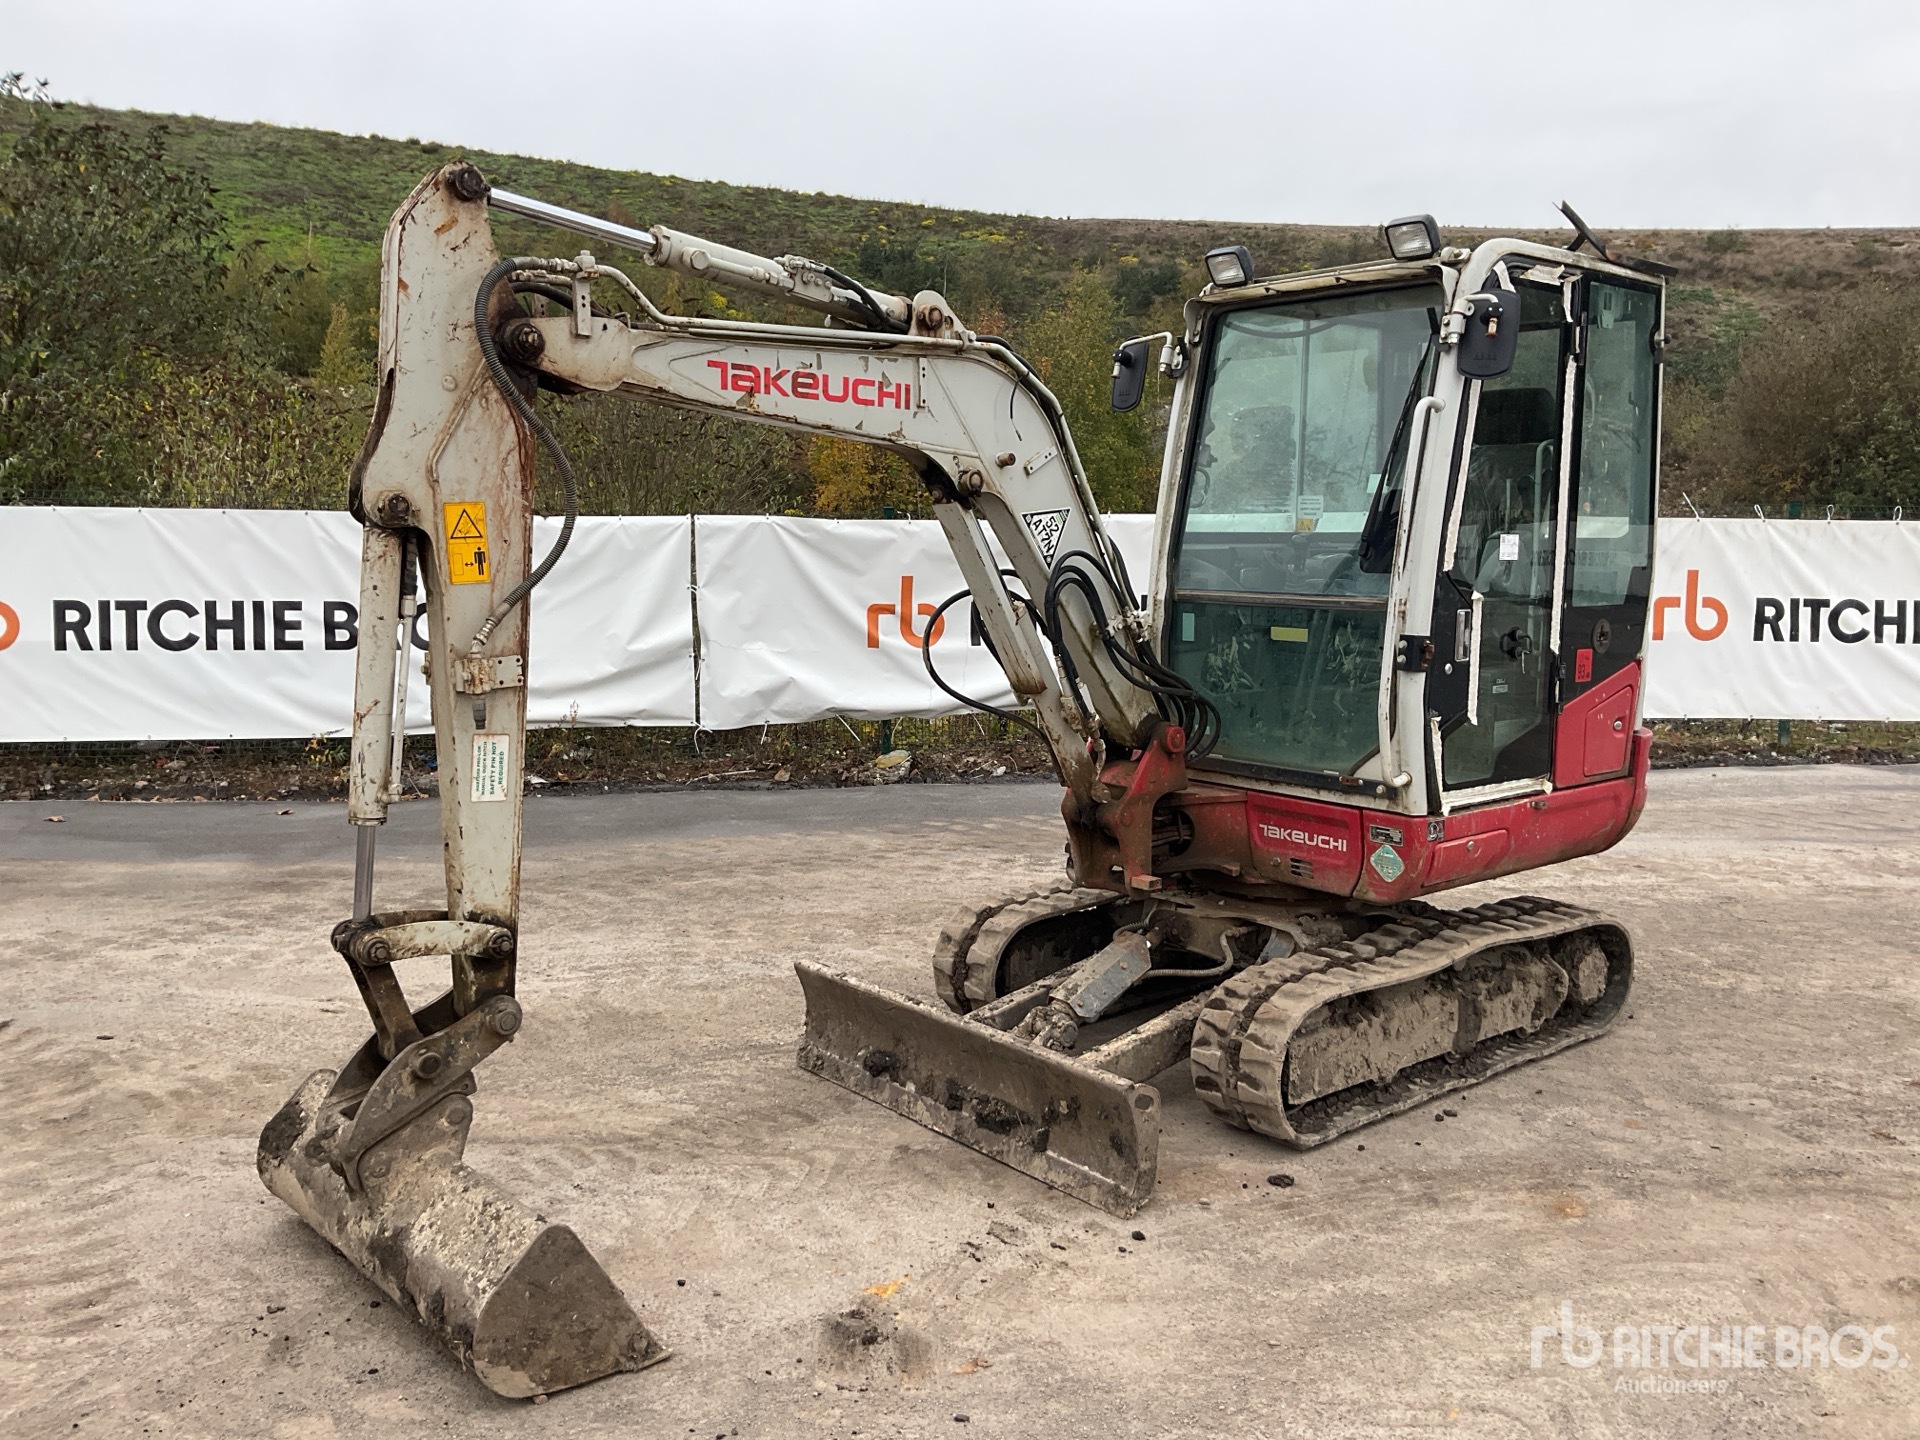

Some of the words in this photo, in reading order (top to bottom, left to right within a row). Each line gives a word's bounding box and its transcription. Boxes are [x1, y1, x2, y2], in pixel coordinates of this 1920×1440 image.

[1032, 518, 1055, 554] AT7N
[1045, 516, 1060, 538] 52
[52, 599, 304, 652] RITCHIE
[1651, 569, 1729, 642] rb
